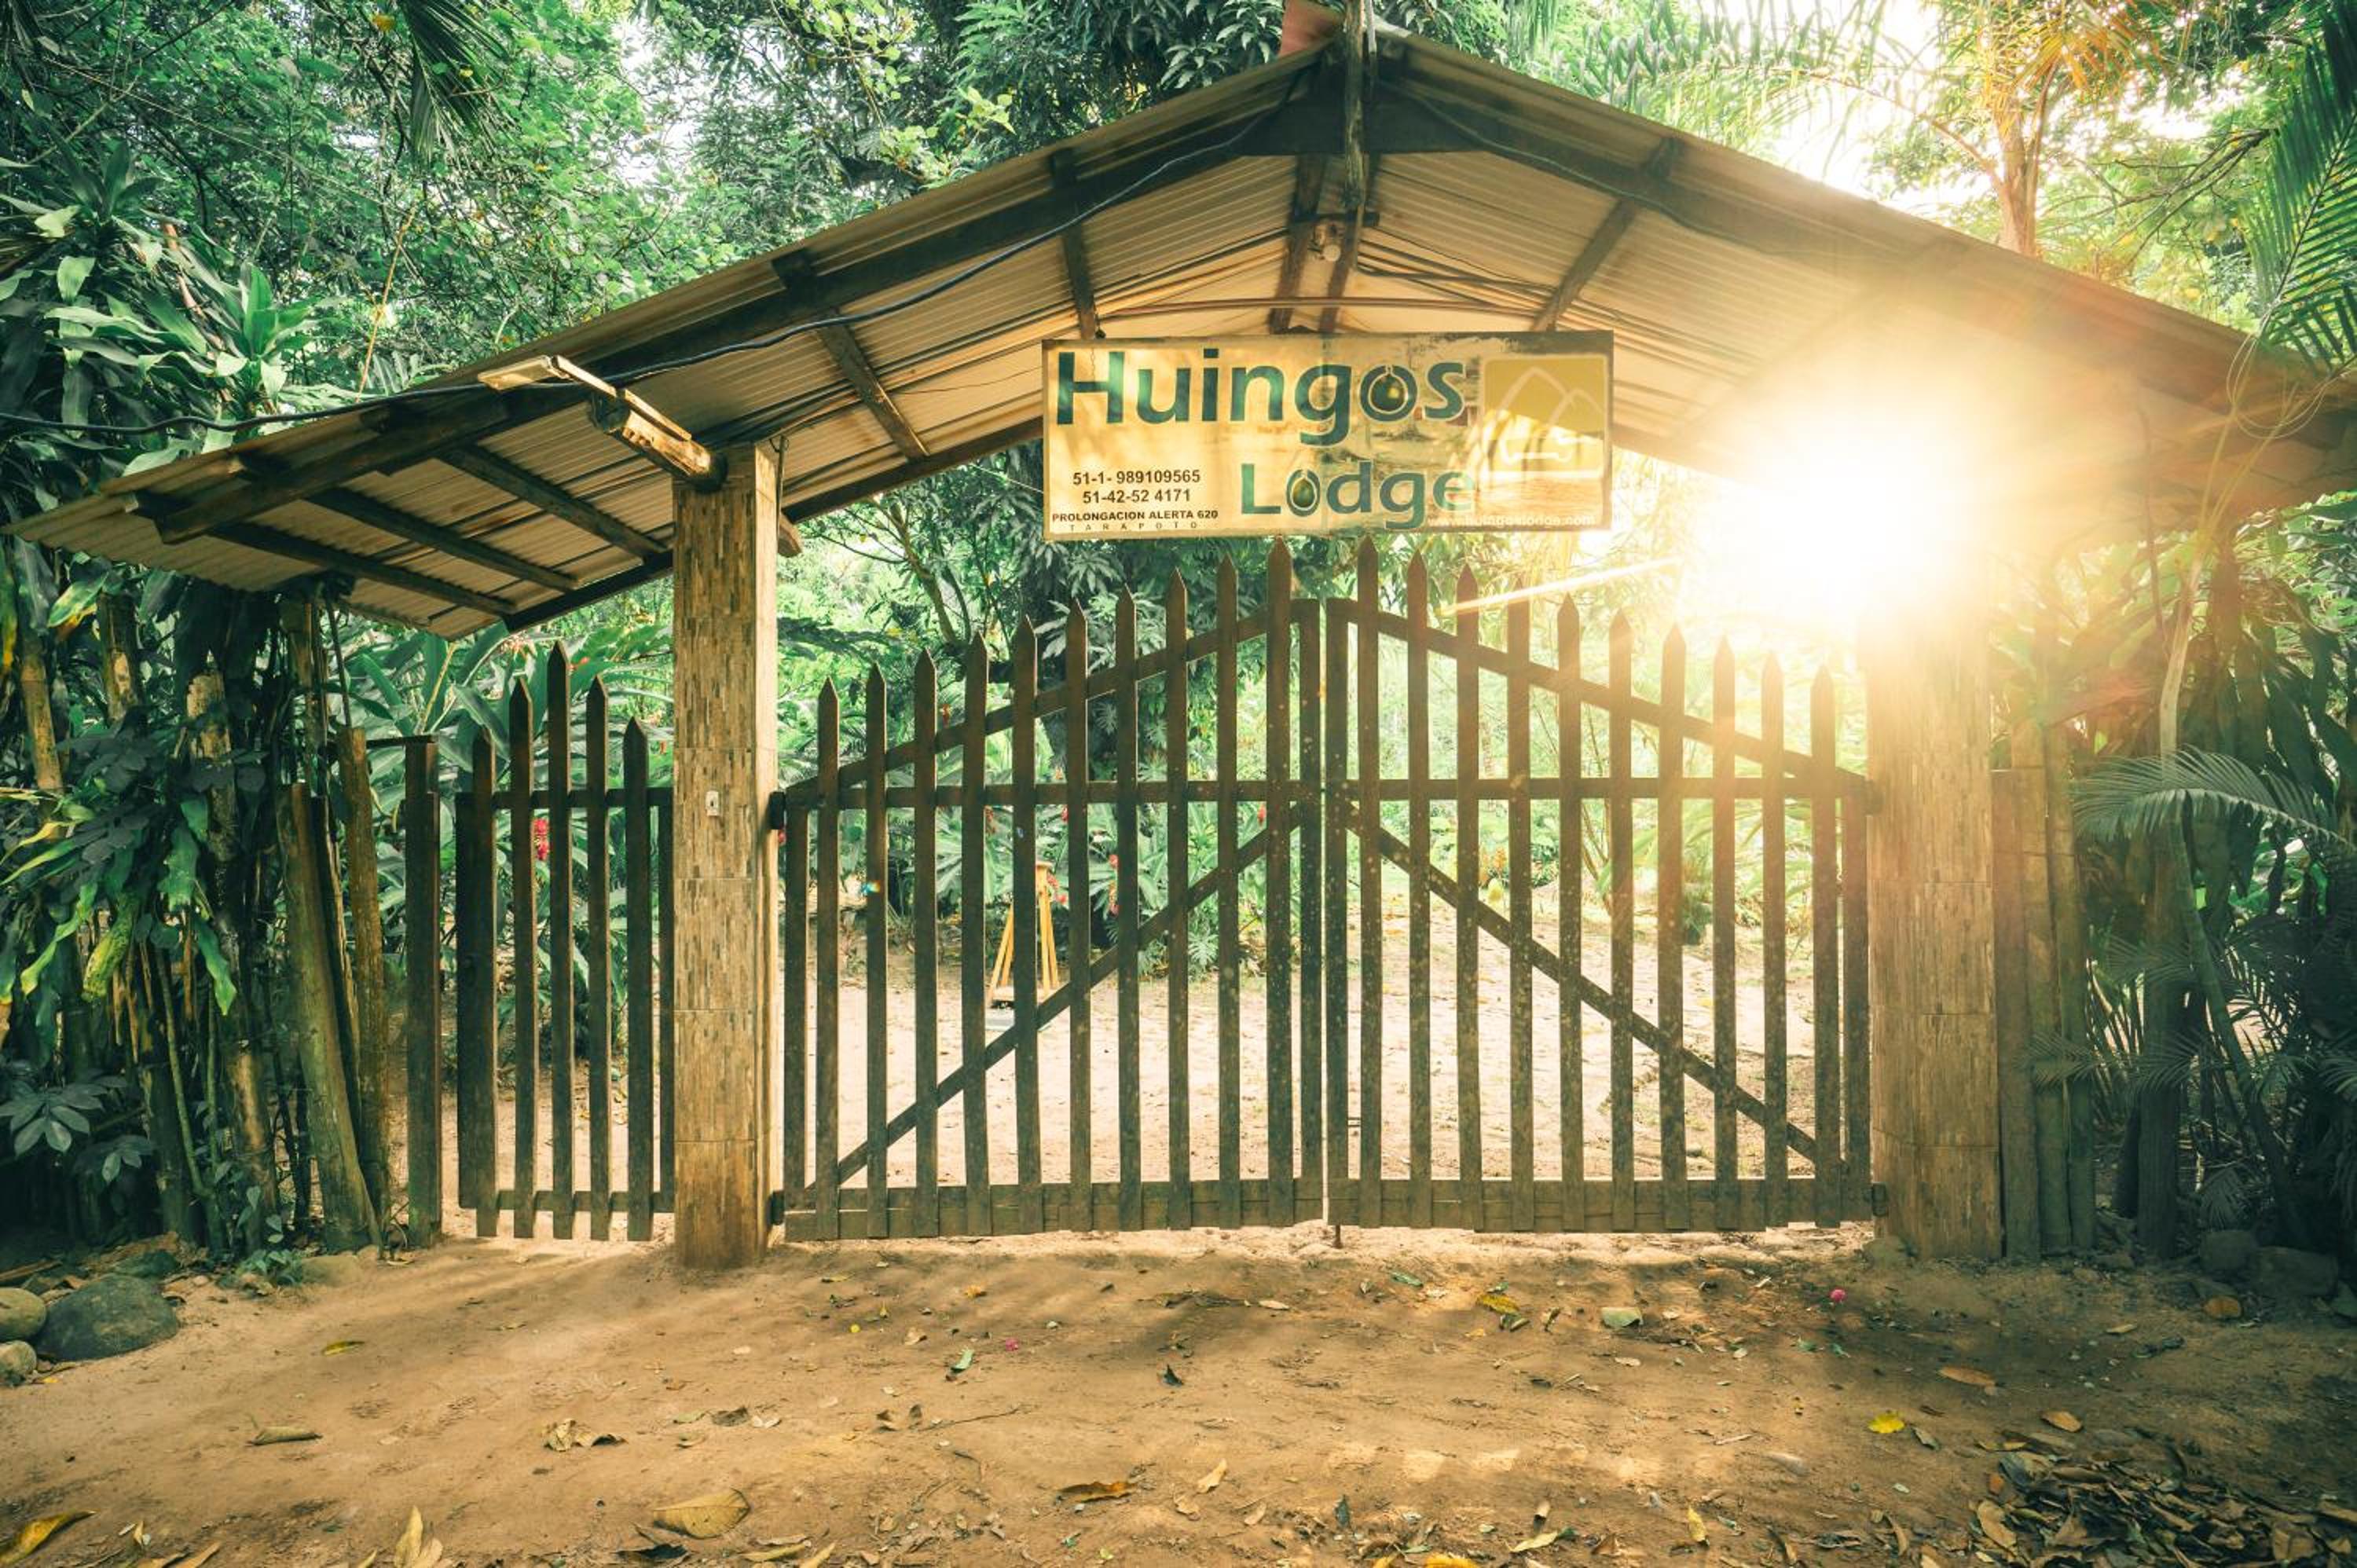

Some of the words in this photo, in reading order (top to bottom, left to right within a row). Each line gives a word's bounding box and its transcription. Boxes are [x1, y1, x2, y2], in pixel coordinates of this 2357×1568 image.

[1055, 348, 1466, 447] Huingos
[1116, 470, 1200, 484] 989109565
[1083, 489, 1149, 504] 51-42-52
[1154, 489, 1191, 502] 4171
[1241, 460, 1475, 529] Lodge
[1052, 511, 1145, 522] PROLONGACION
[1149, 510, 1193, 520] ALERTA
[1197, 510, 1219, 519] 620
